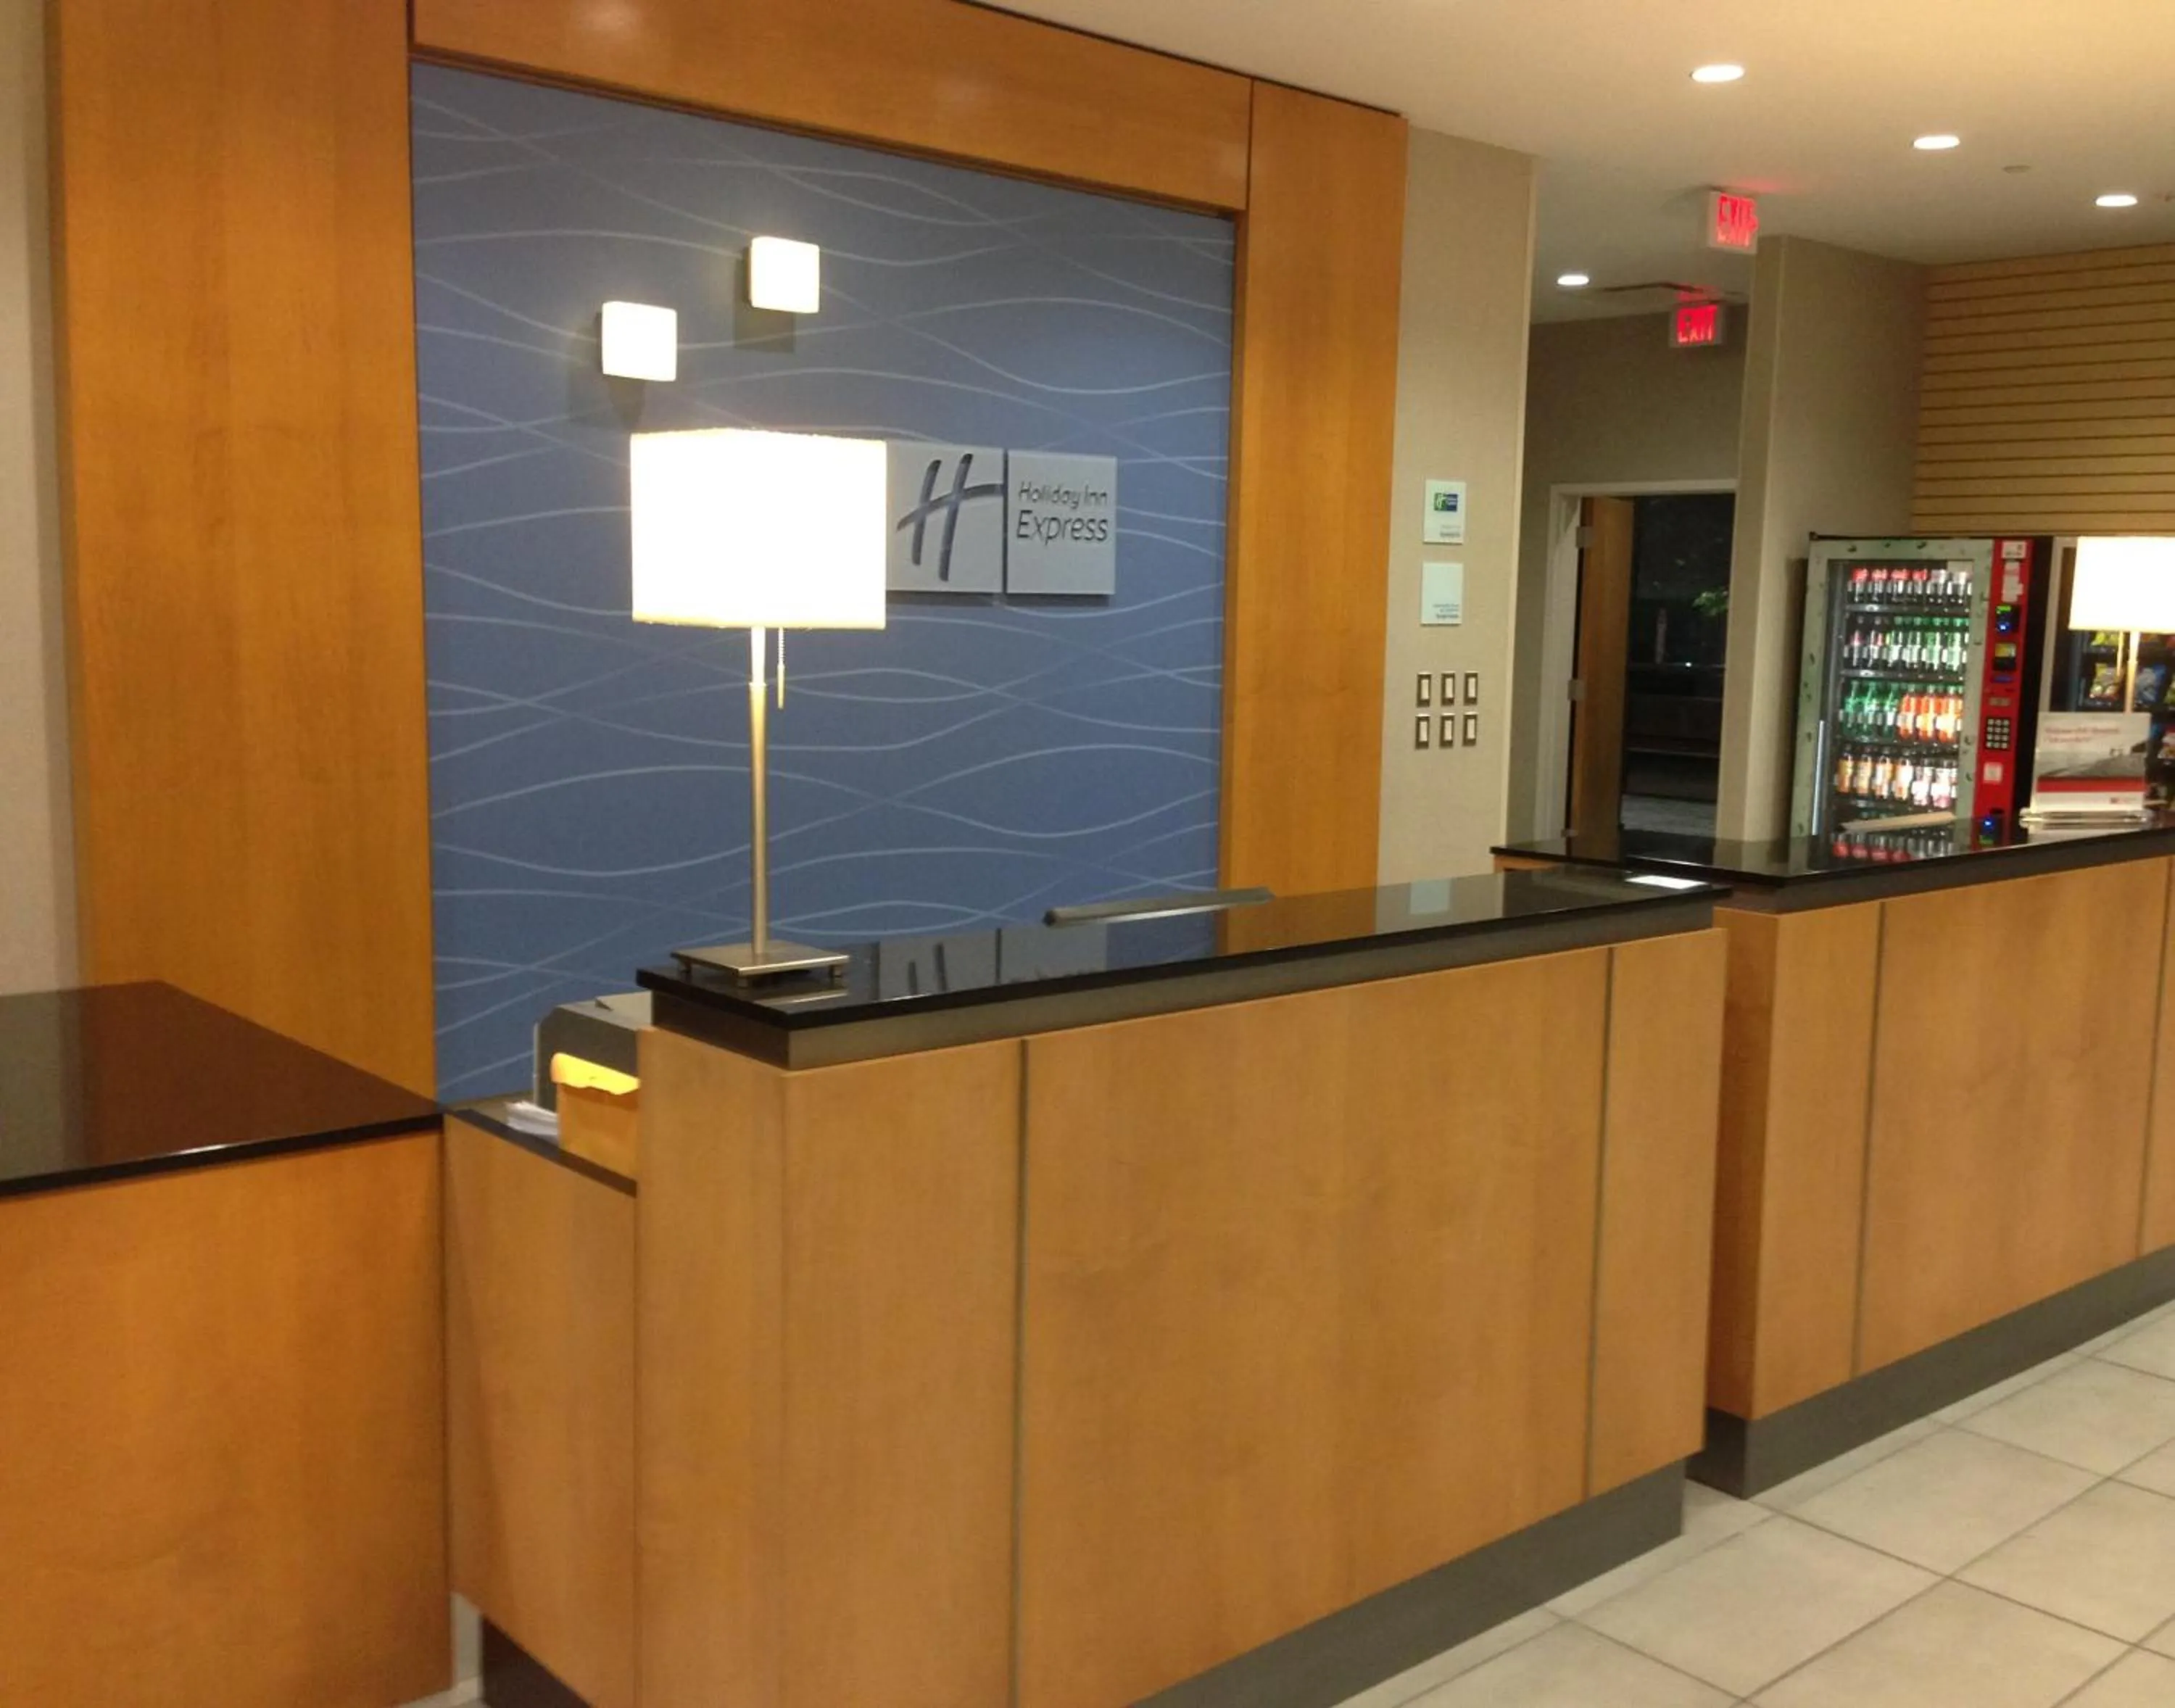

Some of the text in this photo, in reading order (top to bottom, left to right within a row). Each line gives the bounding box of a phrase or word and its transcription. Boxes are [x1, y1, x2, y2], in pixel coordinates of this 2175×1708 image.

[1717, 194, 1756, 247] EXIT
[1677, 304, 1717, 343] EXIT
[1019, 480, 1108, 510] Holiday Inn
[1016, 510, 1108, 546] Express
